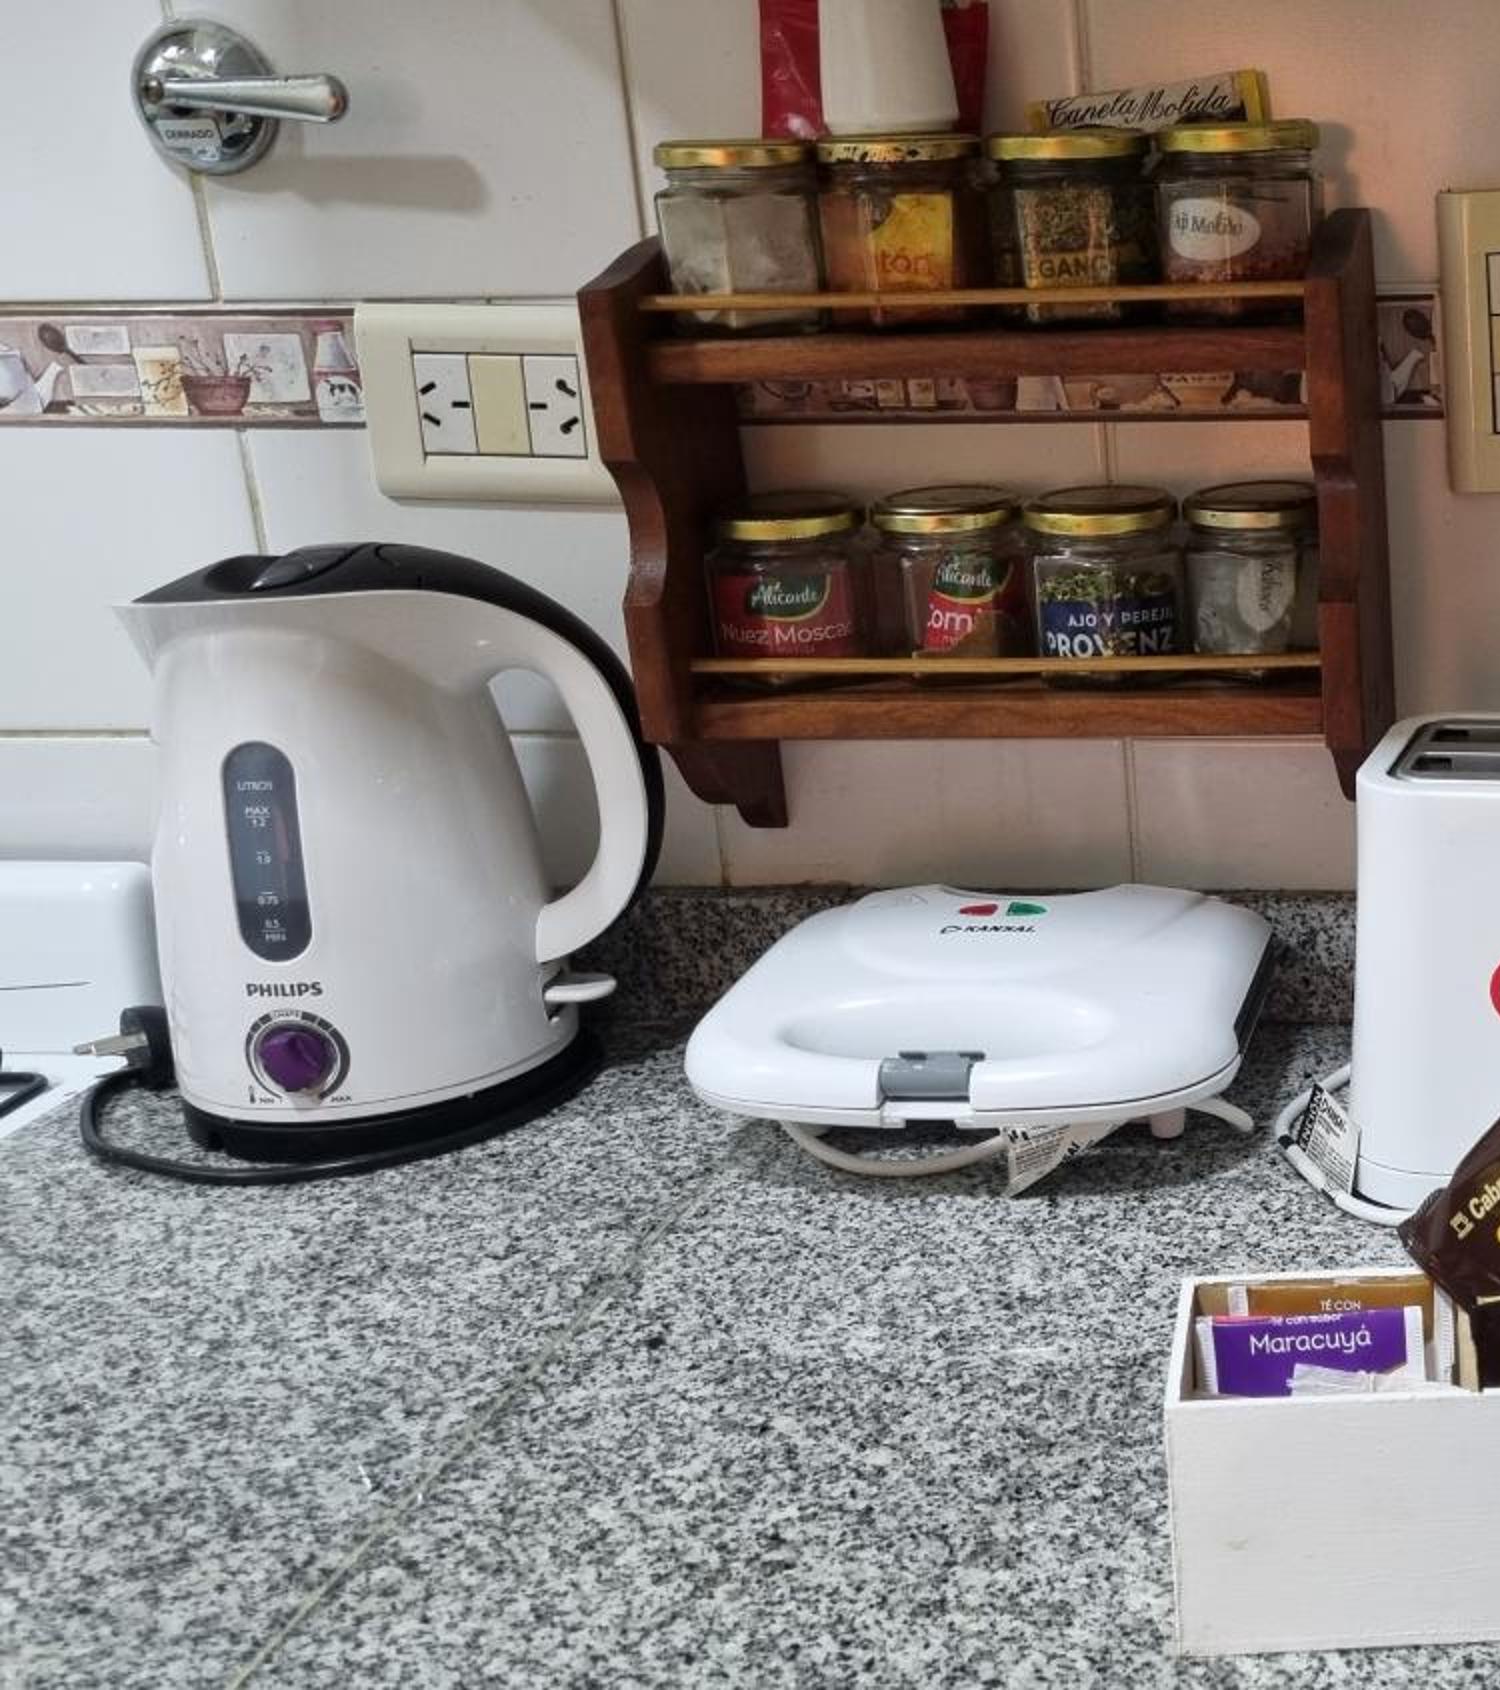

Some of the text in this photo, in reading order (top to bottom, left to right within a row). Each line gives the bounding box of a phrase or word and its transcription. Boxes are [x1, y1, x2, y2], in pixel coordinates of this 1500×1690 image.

[1050, 84, 1231, 127] Canela Molida
[1068, 613, 1098, 628] AJO
[1101, 612, 1115, 627] Y
[722, 623, 769, 645] Nuez
[245, 807, 271, 816] MAX
[246, 981, 323, 997] PHILIPS
[1320, 1299, 1361, 1312] TÉ CON
[1250, 1324, 1372, 1356] Maracuyá
